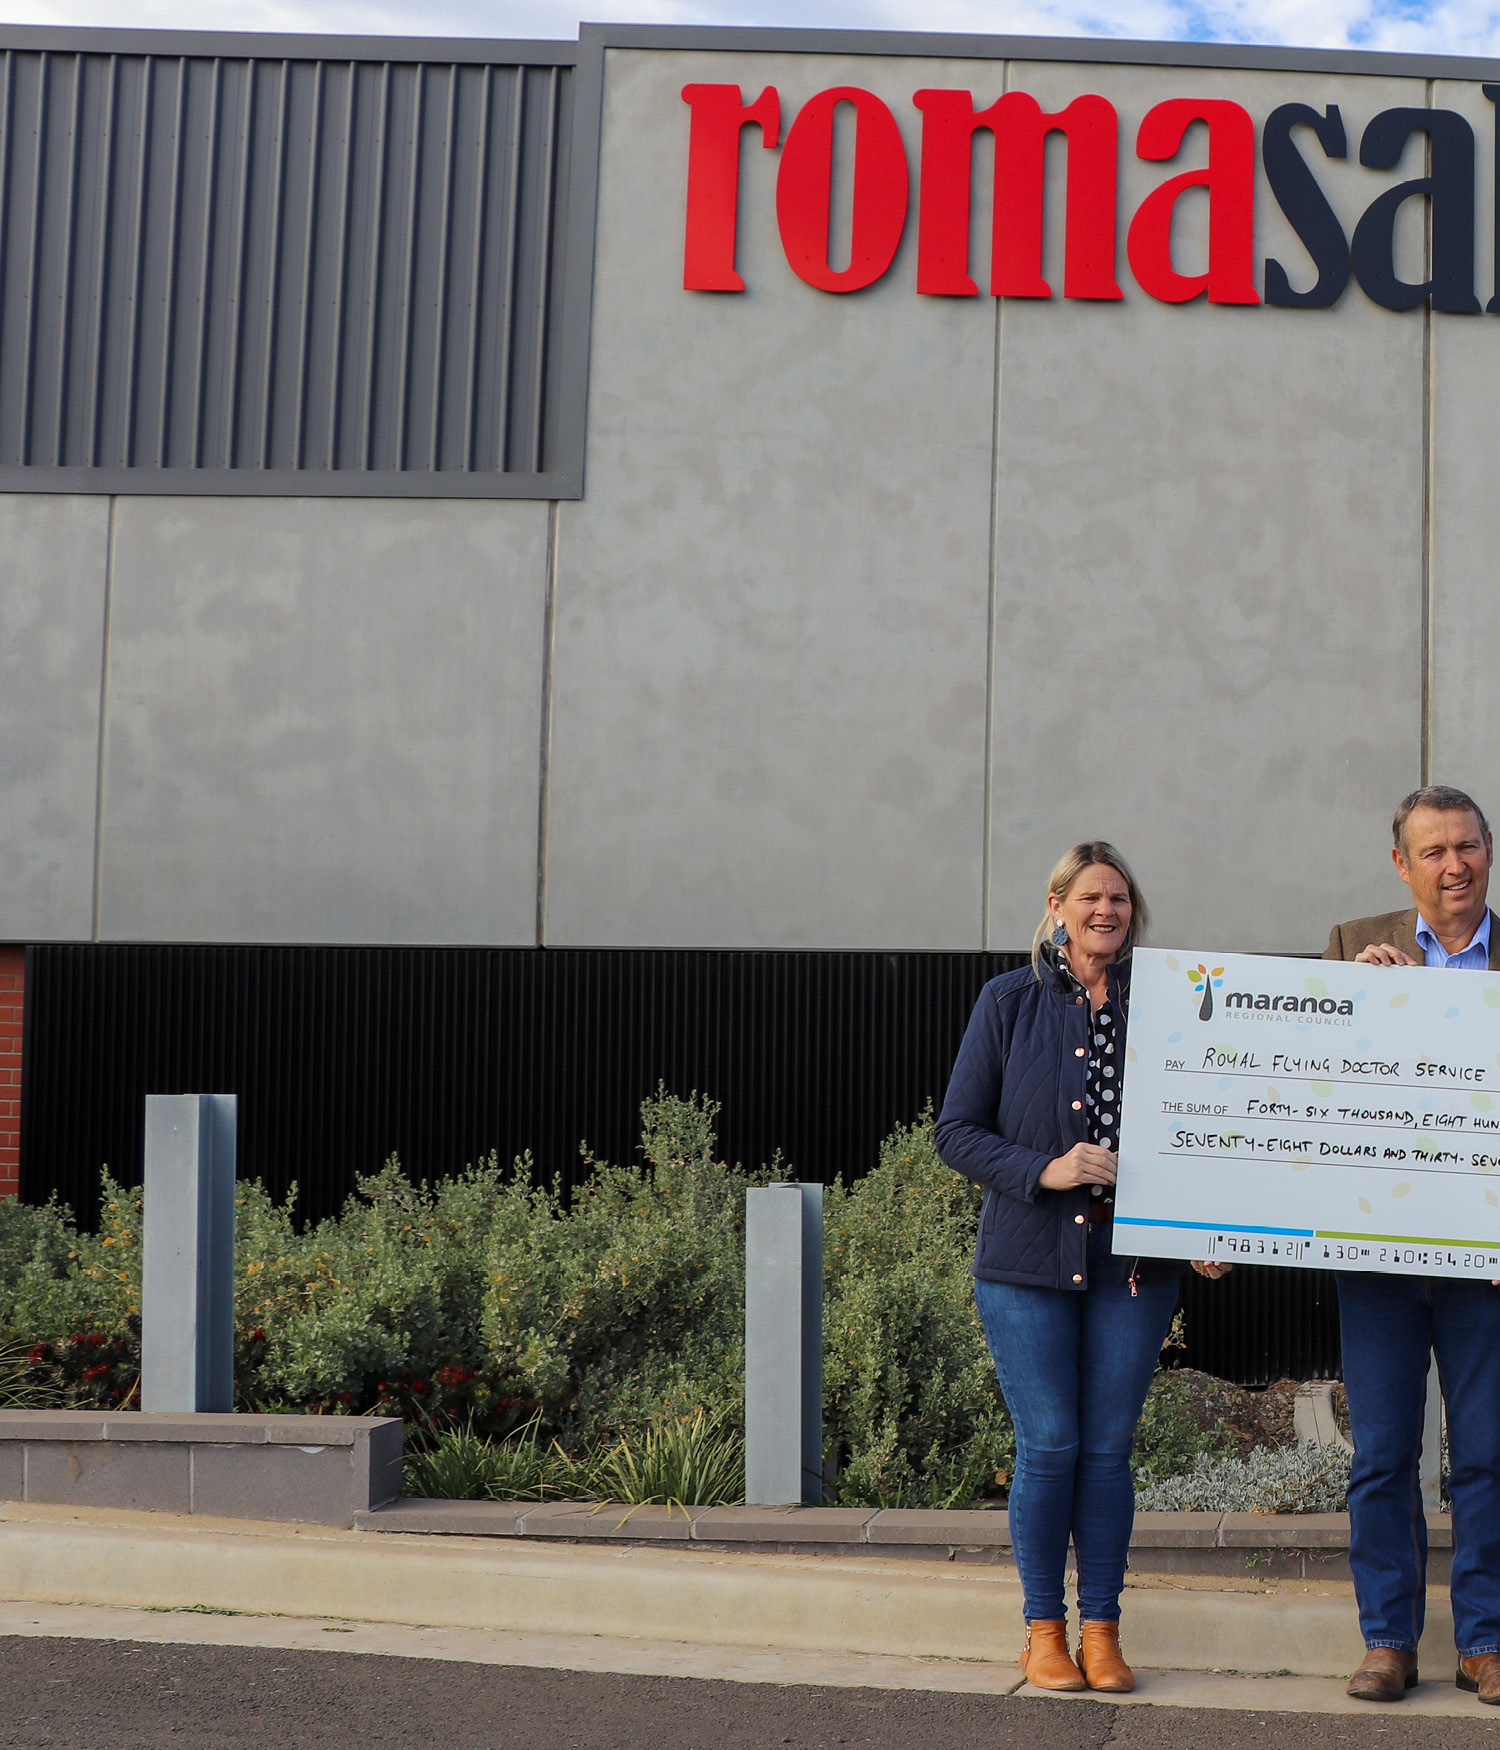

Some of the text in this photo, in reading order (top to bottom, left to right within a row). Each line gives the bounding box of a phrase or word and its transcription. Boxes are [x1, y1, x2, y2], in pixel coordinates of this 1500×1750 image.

[1225, 992, 1354, 1016] maranoa
[1225, 1011, 1353, 1026] REGIONAL COUNCIL
[1165, 1059, 1186, 1070] PAY
[1202, 1047, 1486, 1082] ROYAL FLYING DOCTOR SERVICE
[1162, 1101, 1229, 1115] THE SUM OF
[1305, 1106, 1330, 1118] SIX
[1338, 1108, 1418, 1129] THOUSAND,
[1422, 1113, 1468, 1128] EIGHT
[1319, 1142, 1377, 1157] DOLLARS
[1383, 1147, 1407, 1161] AND
